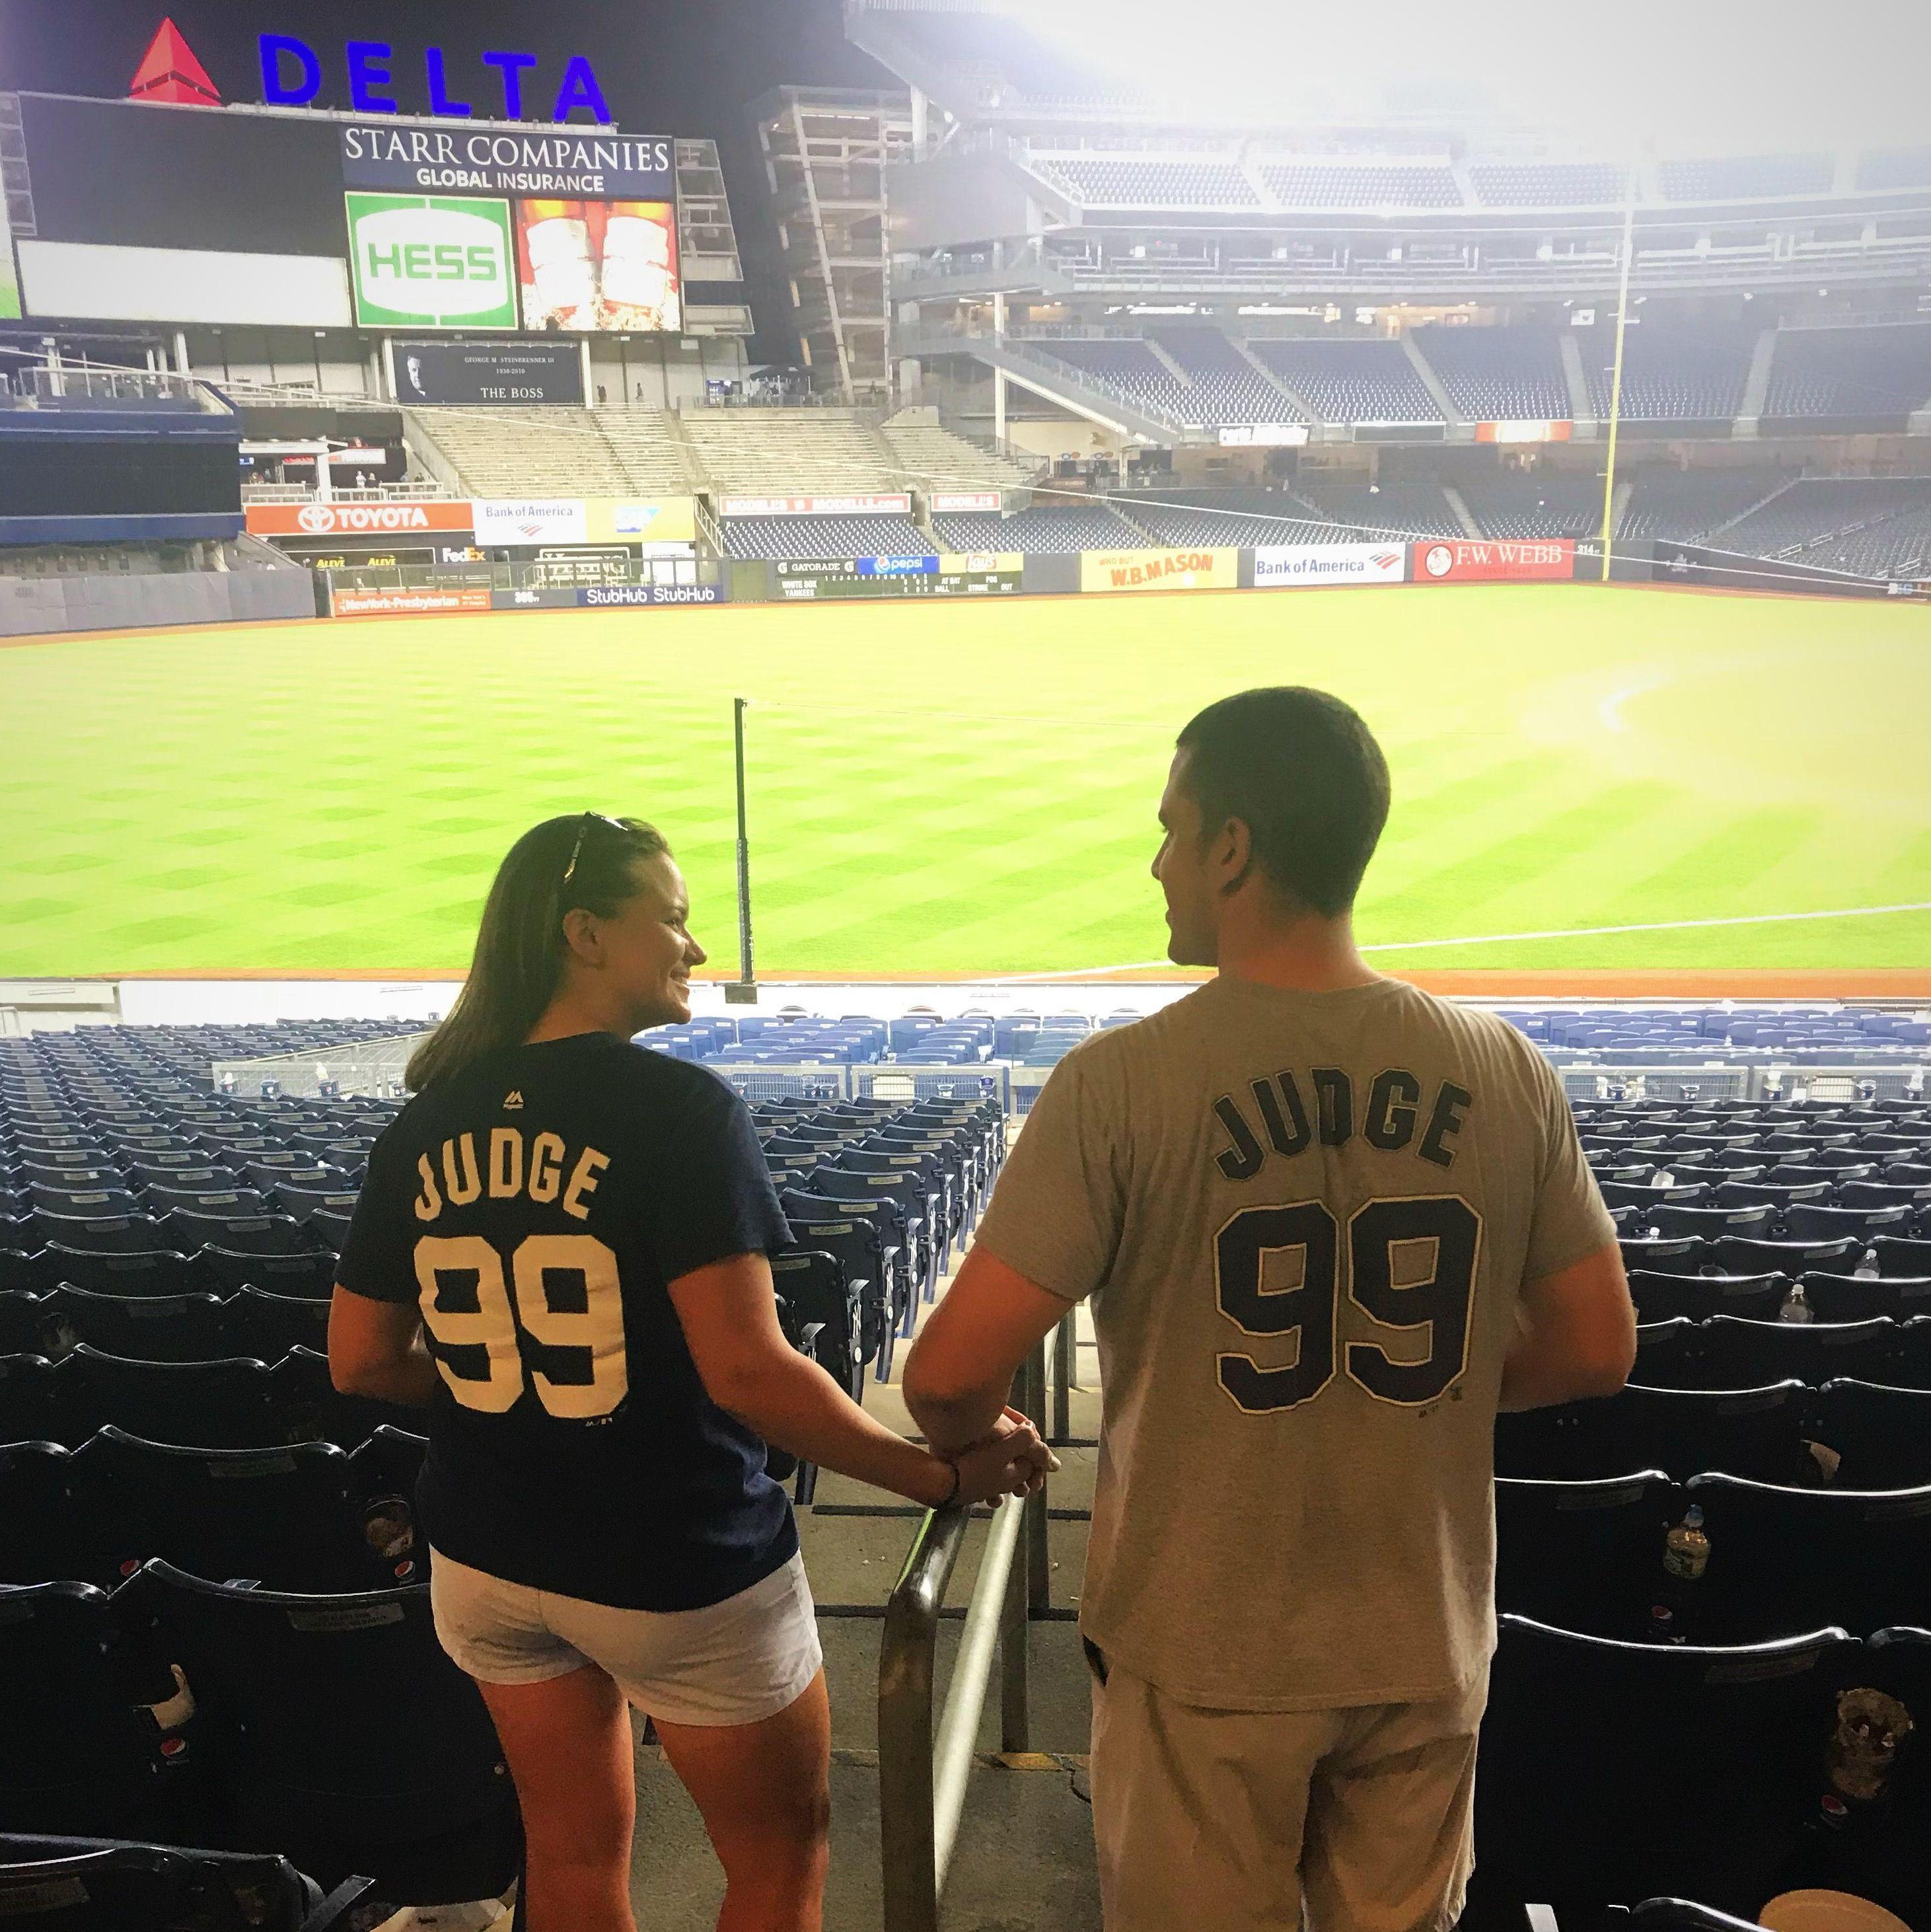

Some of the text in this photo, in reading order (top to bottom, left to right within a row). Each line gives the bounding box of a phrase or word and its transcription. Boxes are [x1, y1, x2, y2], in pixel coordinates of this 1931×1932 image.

[259, 34, 612, 123] DELTA
[346, 128, 669, 171] STARR COMPANIES
[417, 167, 604, 192] GLOBAL INSURANCE
[368, 242, 497, 282] HESS
[480, 387, 544, 398] THE BOSS
[336, 507, 429, 528] TOYOTA
[486, 504, 573, 517] Bank of America
[442, 546, 485, 562] FedEx
[891, 557, 923, 570] pepsi
[1496, 544, 1563, 564] WEBB
[1257, 558, 1365, 575] Bank of America
[587, 587, 715, 604] StubHub StubHub
[784, 589, 815, 597] YANKEES
[1212, 1066, 1474, 1181] JUDGE
[415, 1127, 611, 1221] JUDGE
[1213, 1194, 1483, 1414] 99
[414, 1234, 629, 1419] 99
